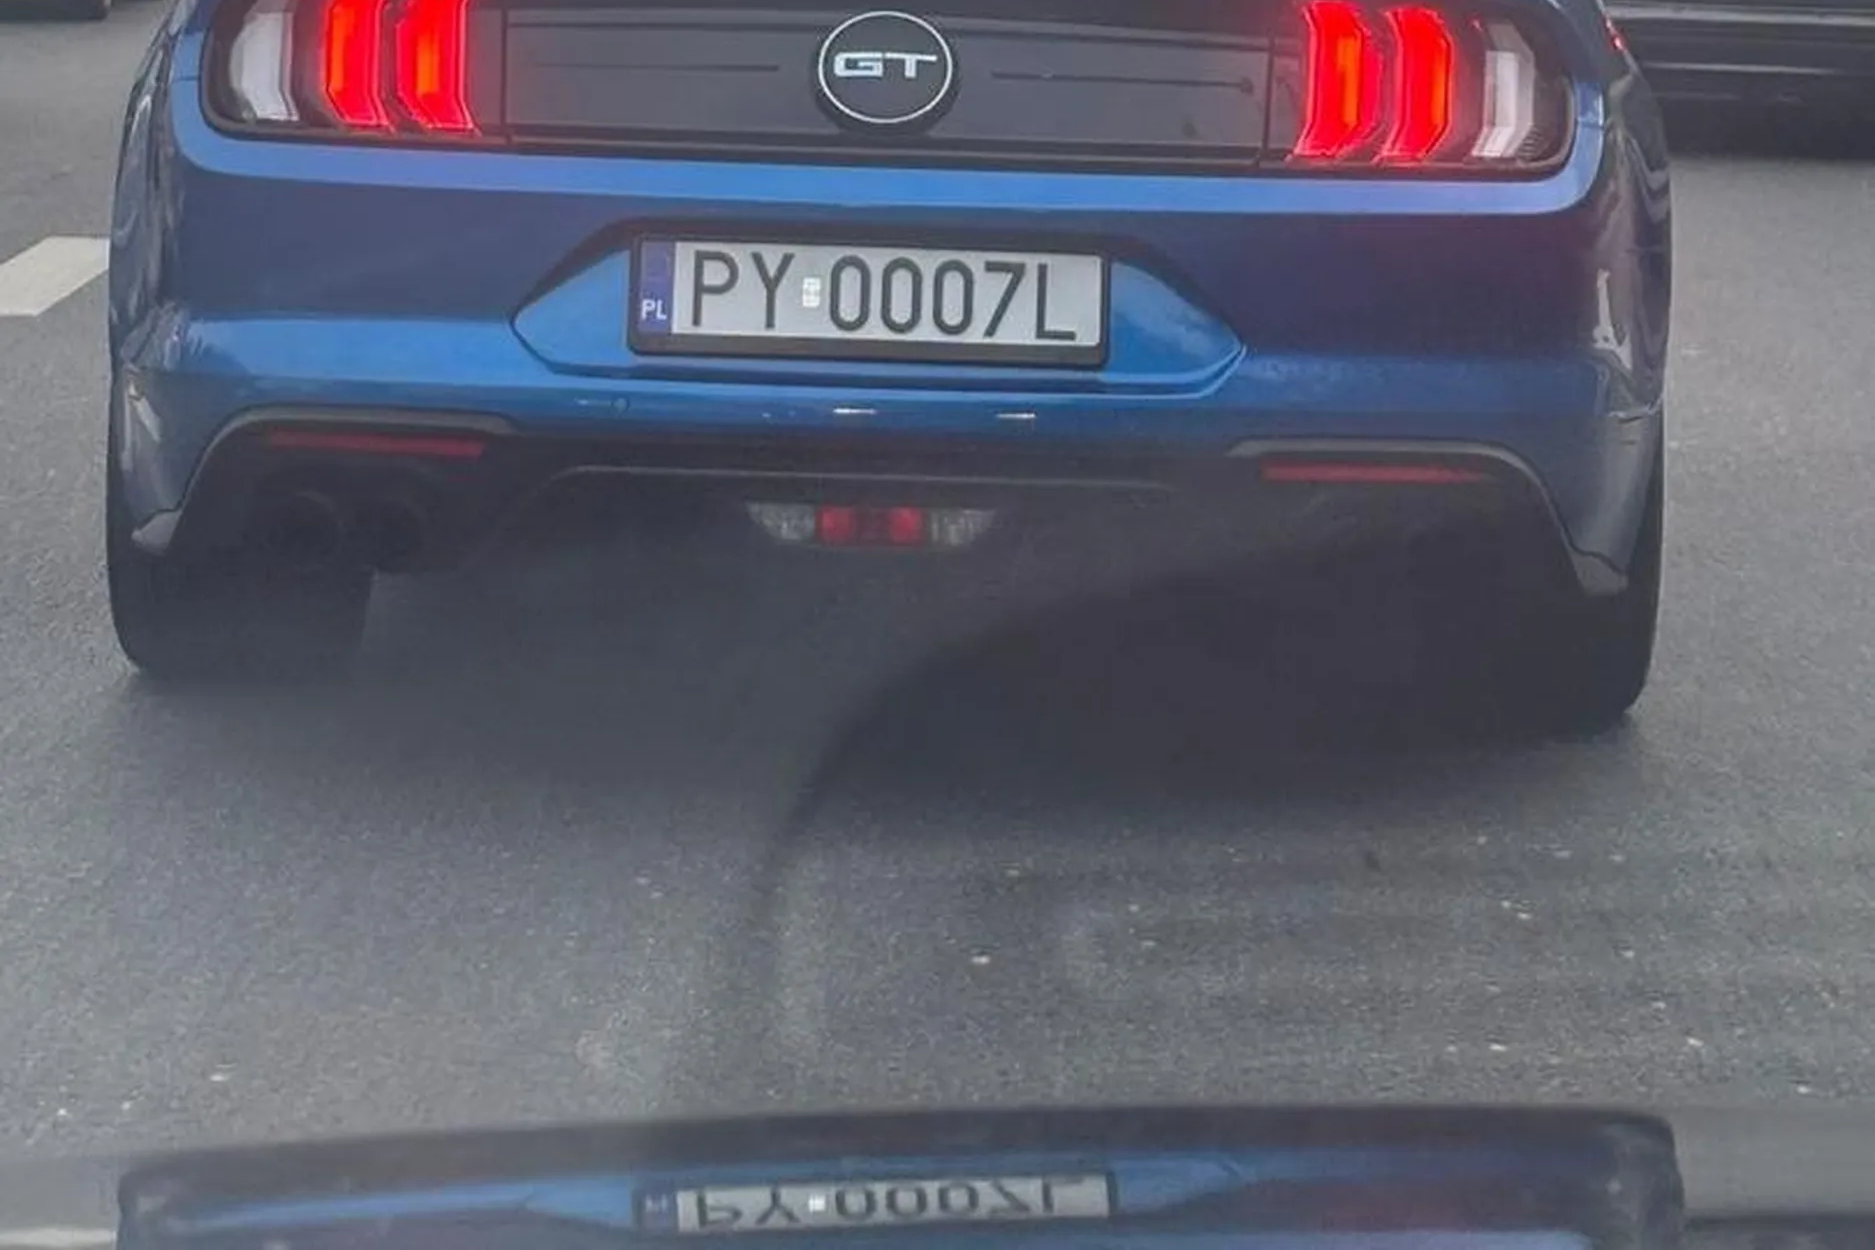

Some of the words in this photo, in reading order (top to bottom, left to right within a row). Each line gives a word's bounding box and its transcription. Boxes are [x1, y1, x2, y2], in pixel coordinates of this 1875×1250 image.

[834, 52, 938, 78] GT
[692, 250, 795, 329] PY
[828, 254, 1077, 341] 0007L
[641, 298, 668, 321] PL
